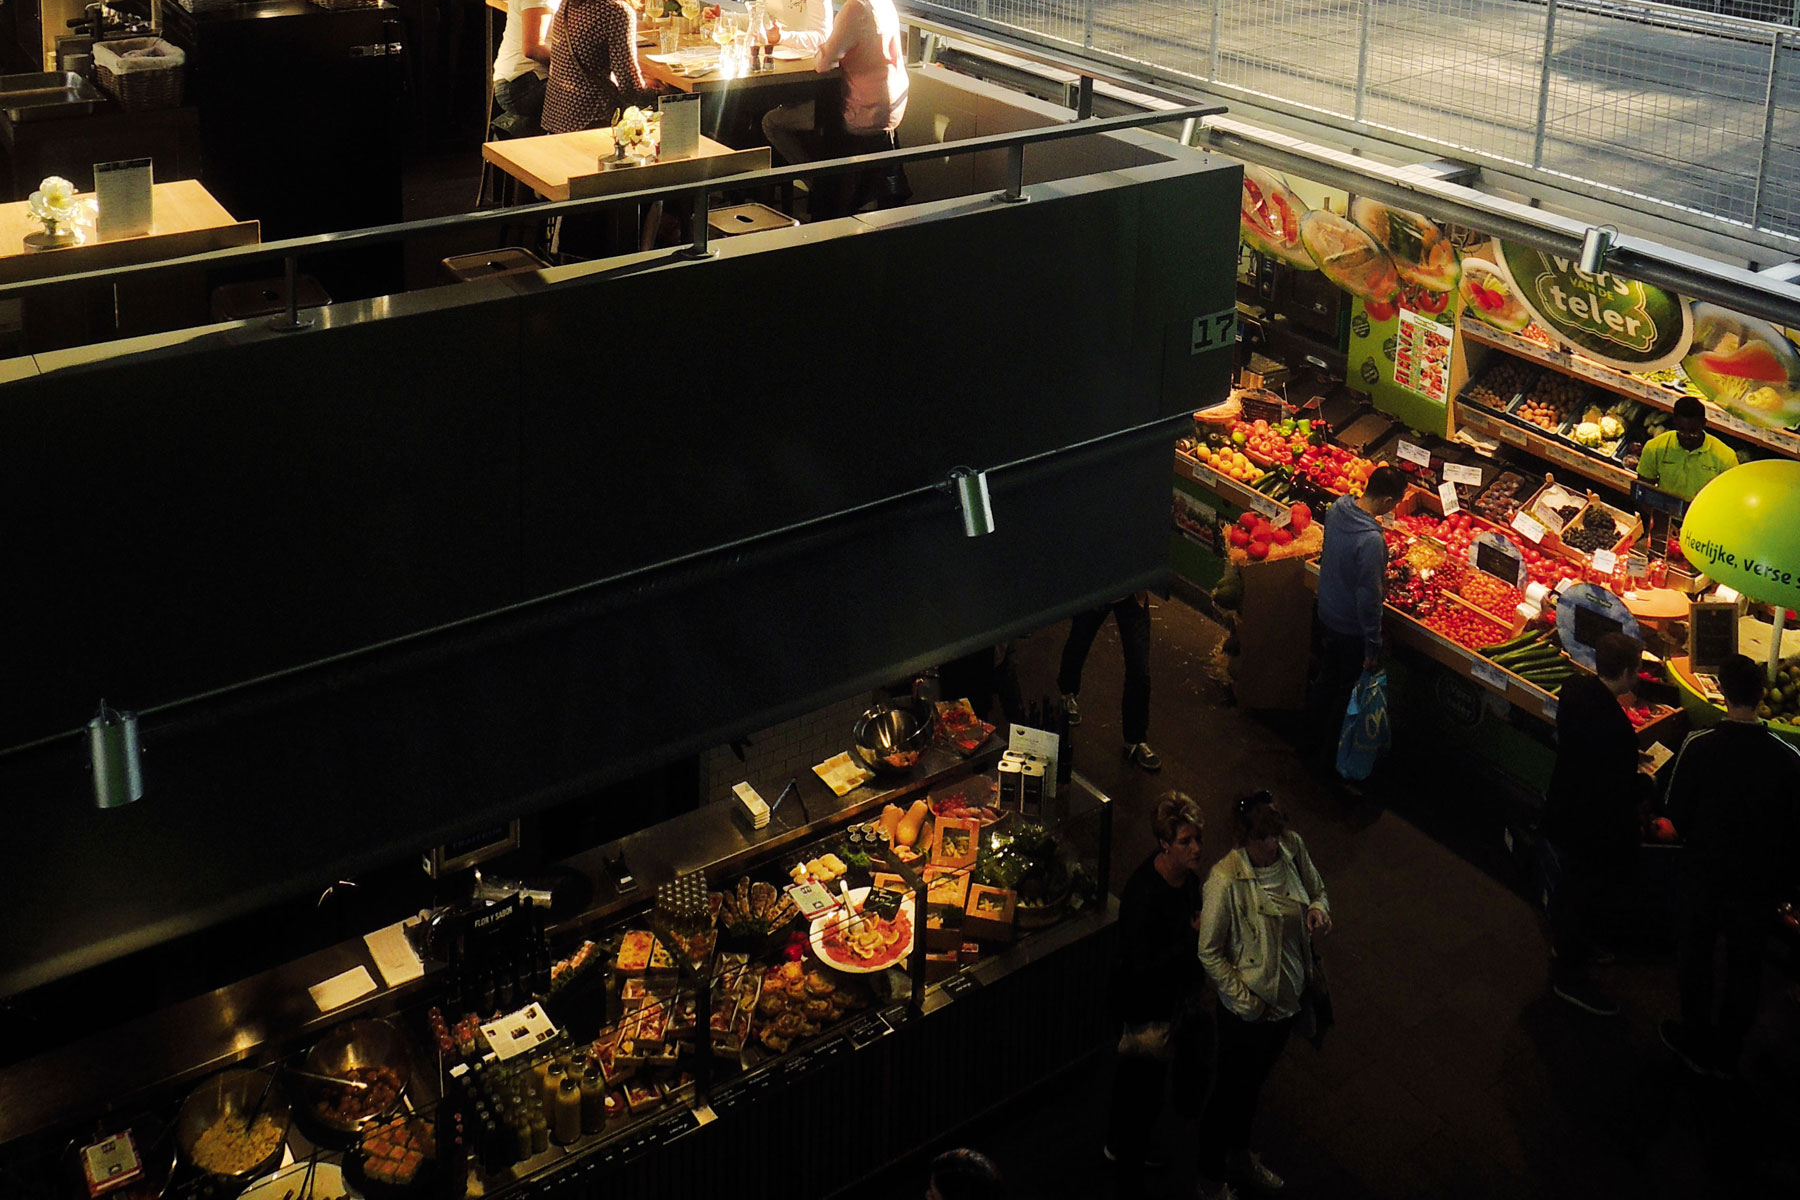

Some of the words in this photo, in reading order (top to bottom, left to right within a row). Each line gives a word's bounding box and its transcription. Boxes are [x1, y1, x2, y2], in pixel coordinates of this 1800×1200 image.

[1569, 276, 1595, 294] VAN
[1598, 287, 1614, 301] DE
[1195, 313, 1234, 349] 17
[1549, 285, 1641, 337] teler
[1684, 529, 1738, 569] Heerlijke,
[1743, 558, 1792, 585] verse
